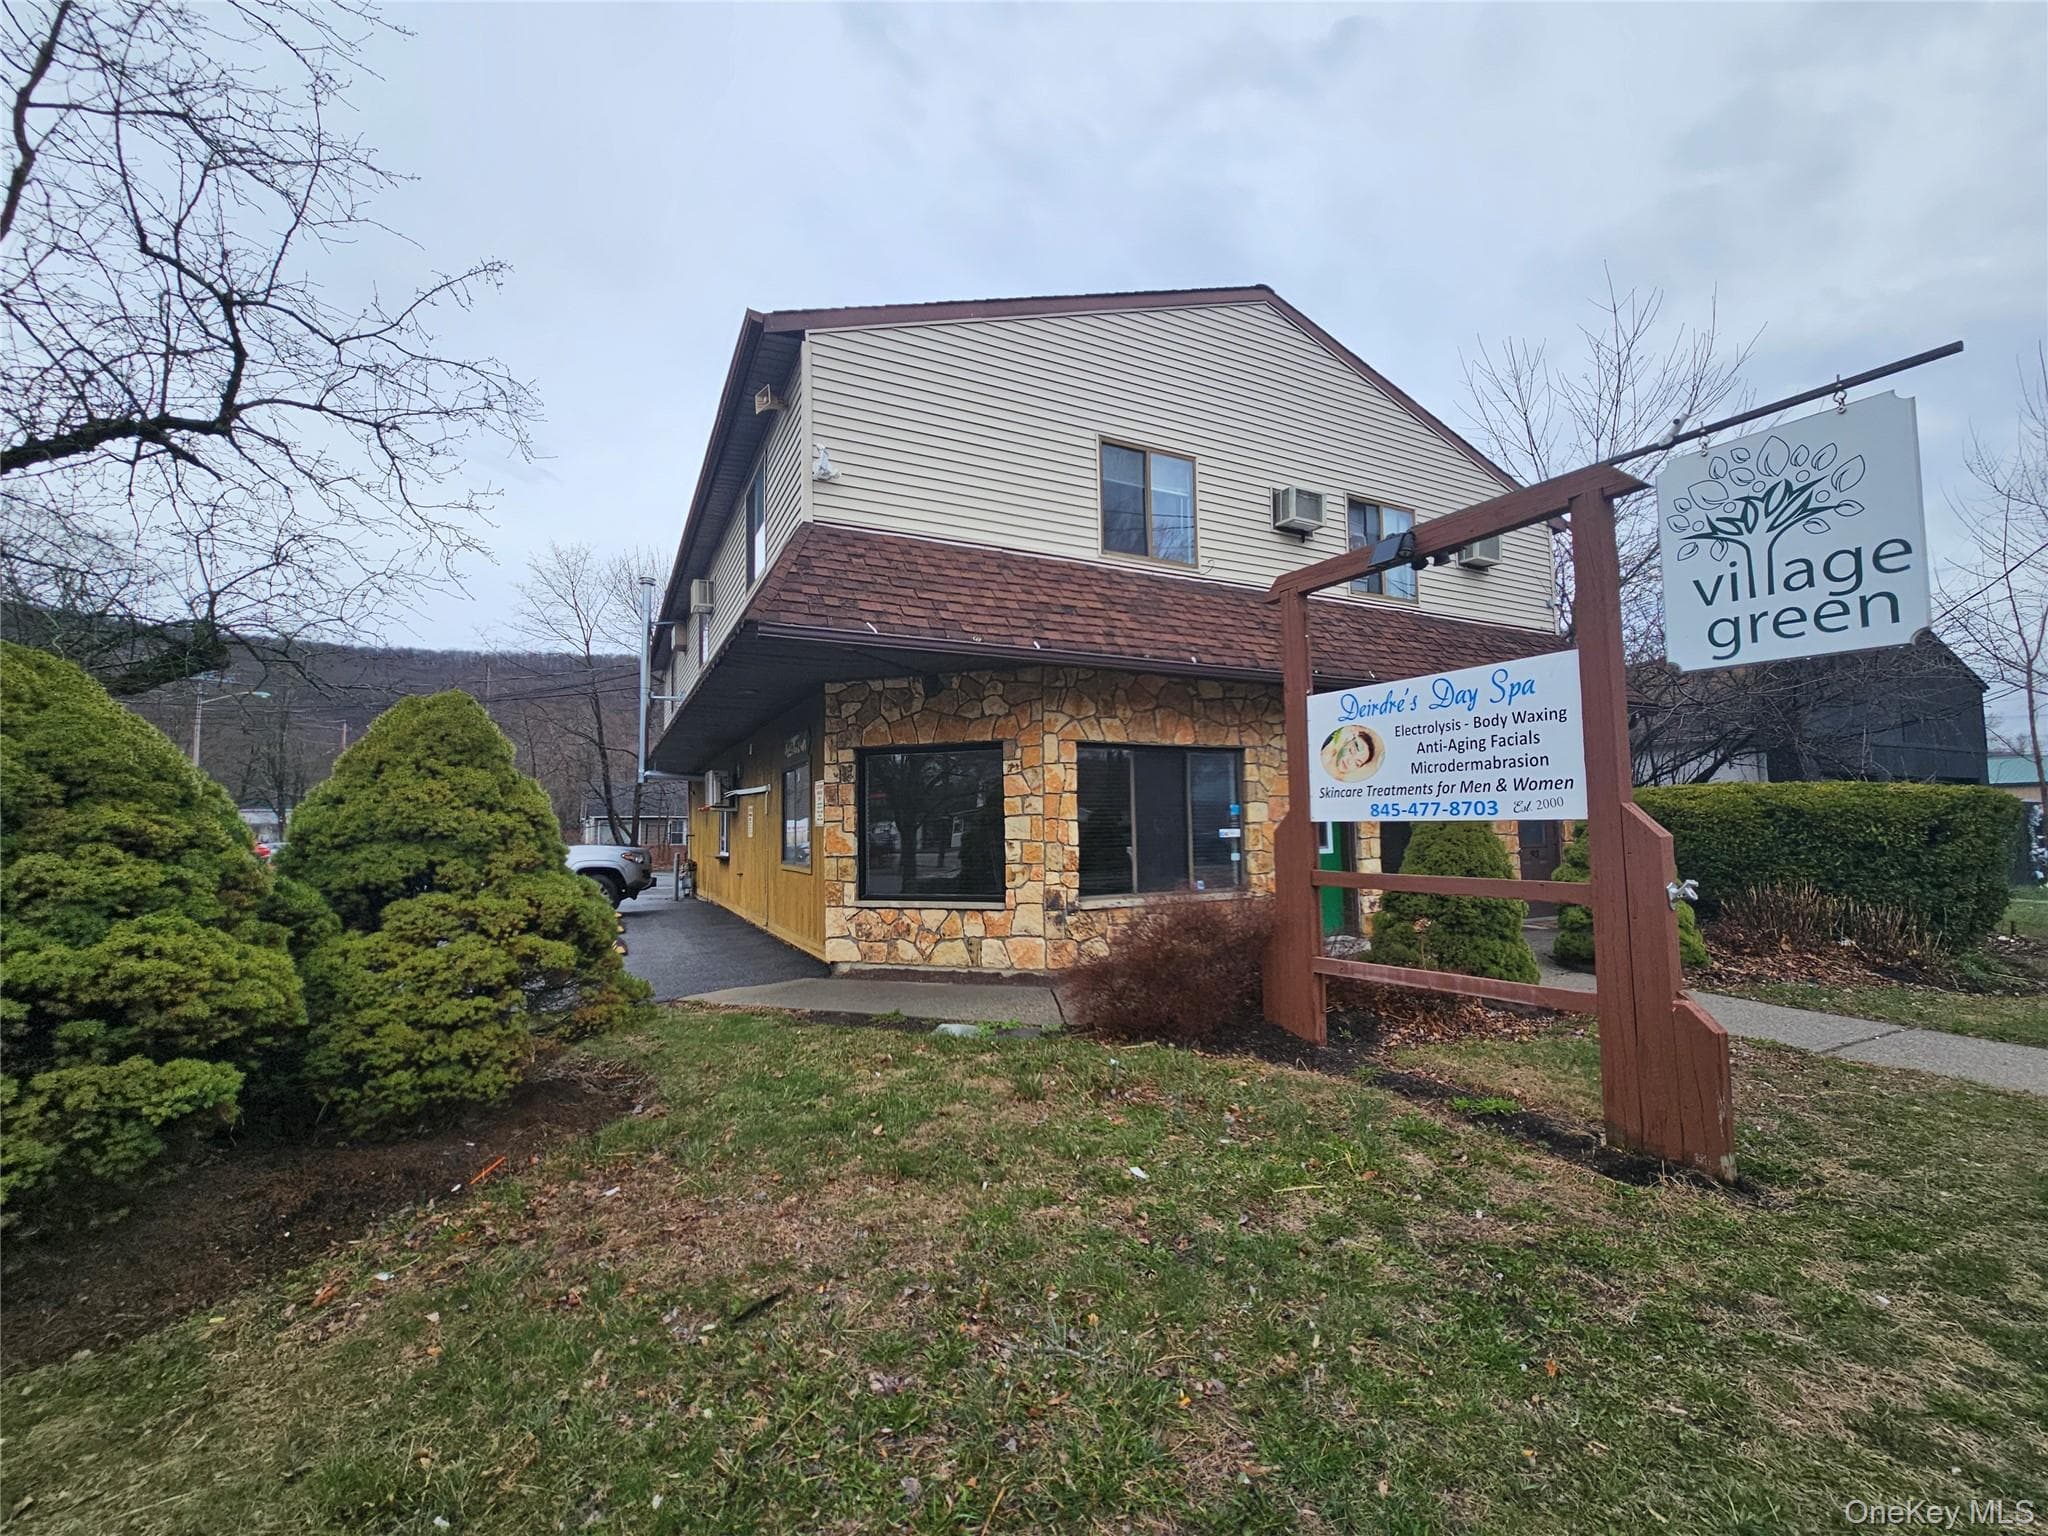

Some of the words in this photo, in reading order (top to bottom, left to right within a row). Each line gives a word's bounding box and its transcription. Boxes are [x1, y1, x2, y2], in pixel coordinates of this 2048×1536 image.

[1692, 538, 1913, 607] village
[1707, 591, 1900, 660] green
[1338, 688, 1418, 721] Deirdre's
[1429, 678, 1478, 712] Day
[1490, 668, 1536, 707] Spa
[1394, 718, 1462, 737] Electrolysis
[1473, 713, 1508, 729] Body
[1512, 707, 1568, 722] Waxing
[1416, 737, 1486, 754] Anti-Aging
[1491, 730, 1541, 748] Facials
[1410, 753, 1549, 775] Microdermabrasion
[1319, 786, 1363, 799] Skincare
[1366, 779, 1433, 798] Treatments
[1436, 780, 1455, 796] for
[1459, 780, 1491, 794] Men
[1496, 778, 1508, 792] &
[1513, 776, 1574, 792] Women
[1370, 800, 1499, 817] 845-477-8703
[1512, 800, 1533, 814] Est.
[1536, 797, 1564, 811] 2000
